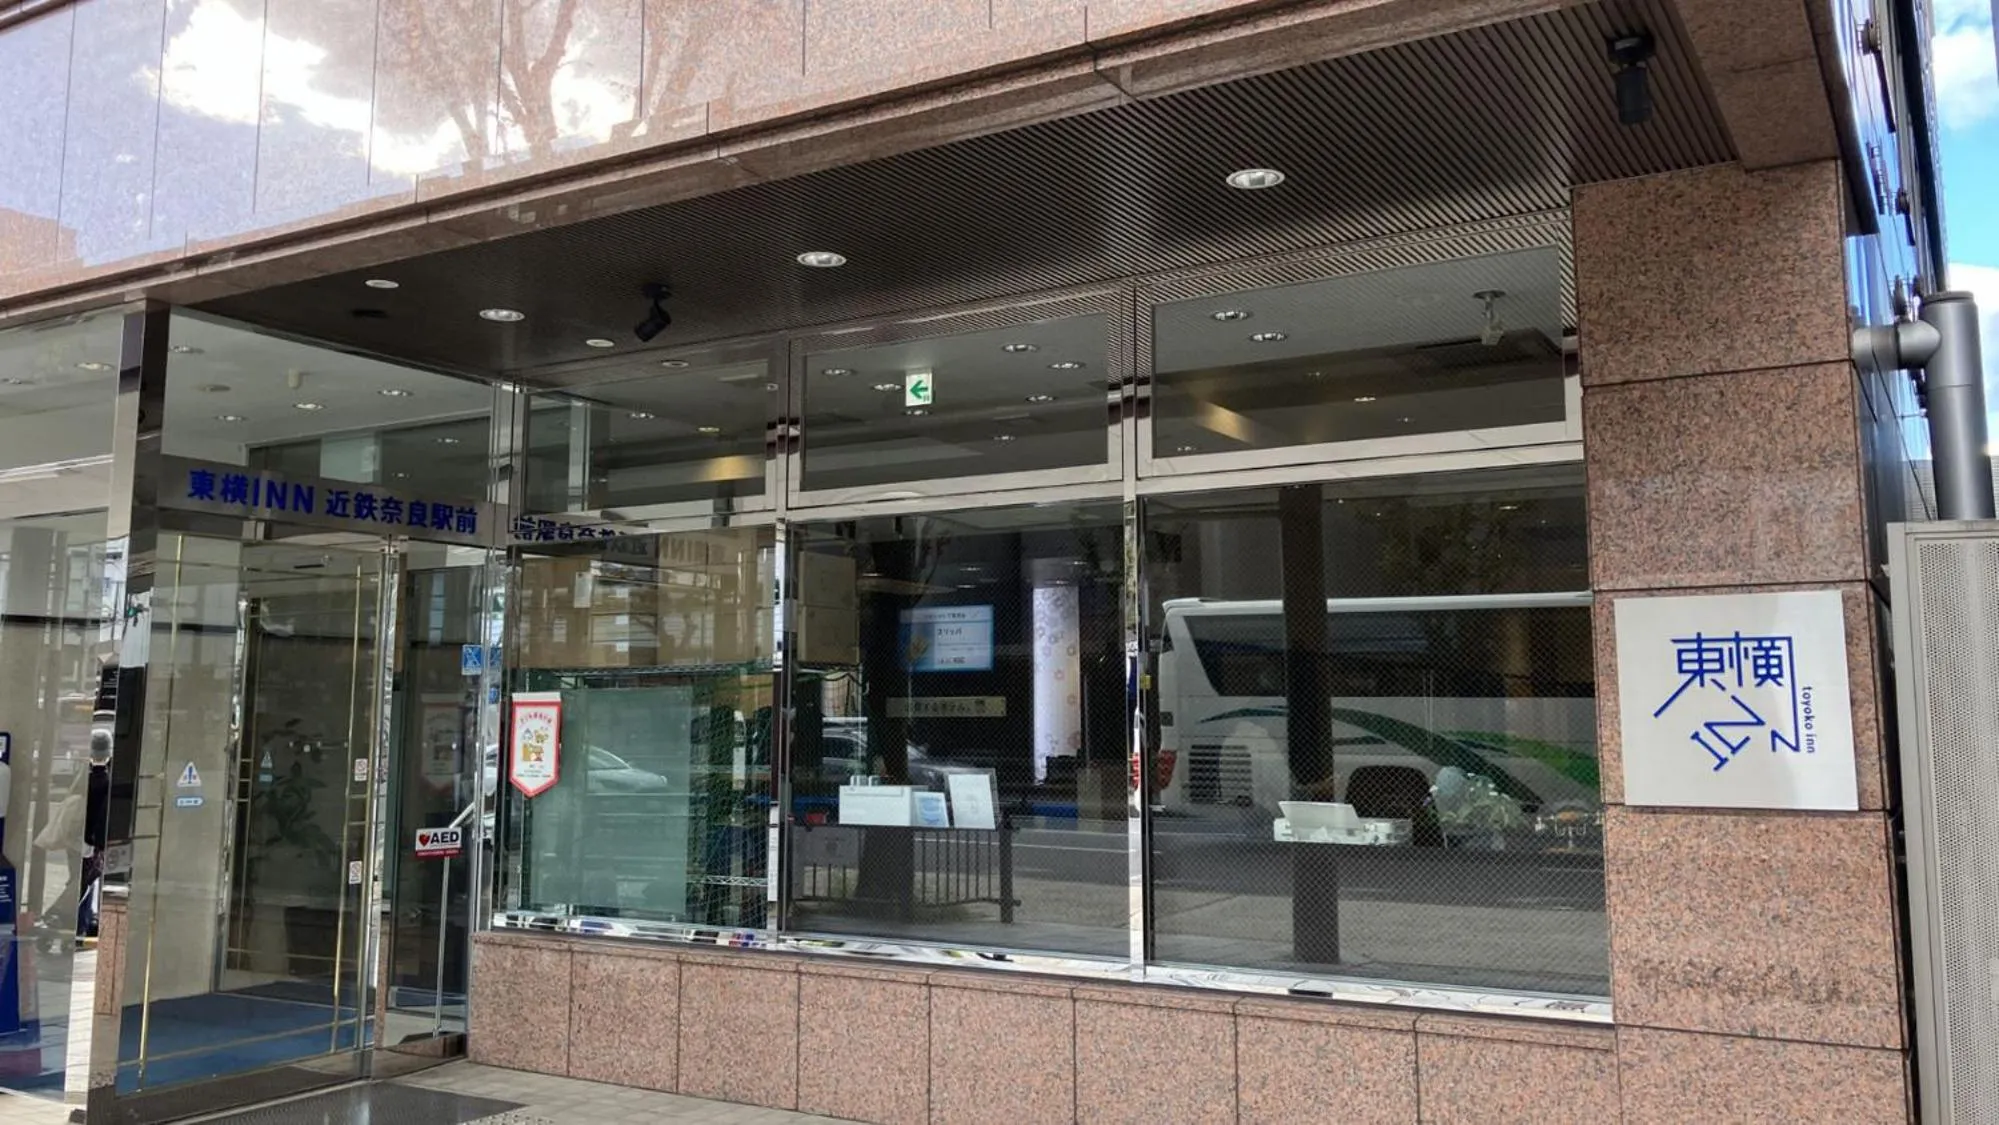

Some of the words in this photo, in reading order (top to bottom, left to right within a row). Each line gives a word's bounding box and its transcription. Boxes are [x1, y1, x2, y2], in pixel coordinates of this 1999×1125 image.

[187, 469, 316, 515] 東横INN
[326, 488, 477, 535] 近鉄奈良駅前
[1801, 686, 1817, 730] toyoko
[1806, 732, 1818, 754] inn
[430, 832, 459, 844] AED
